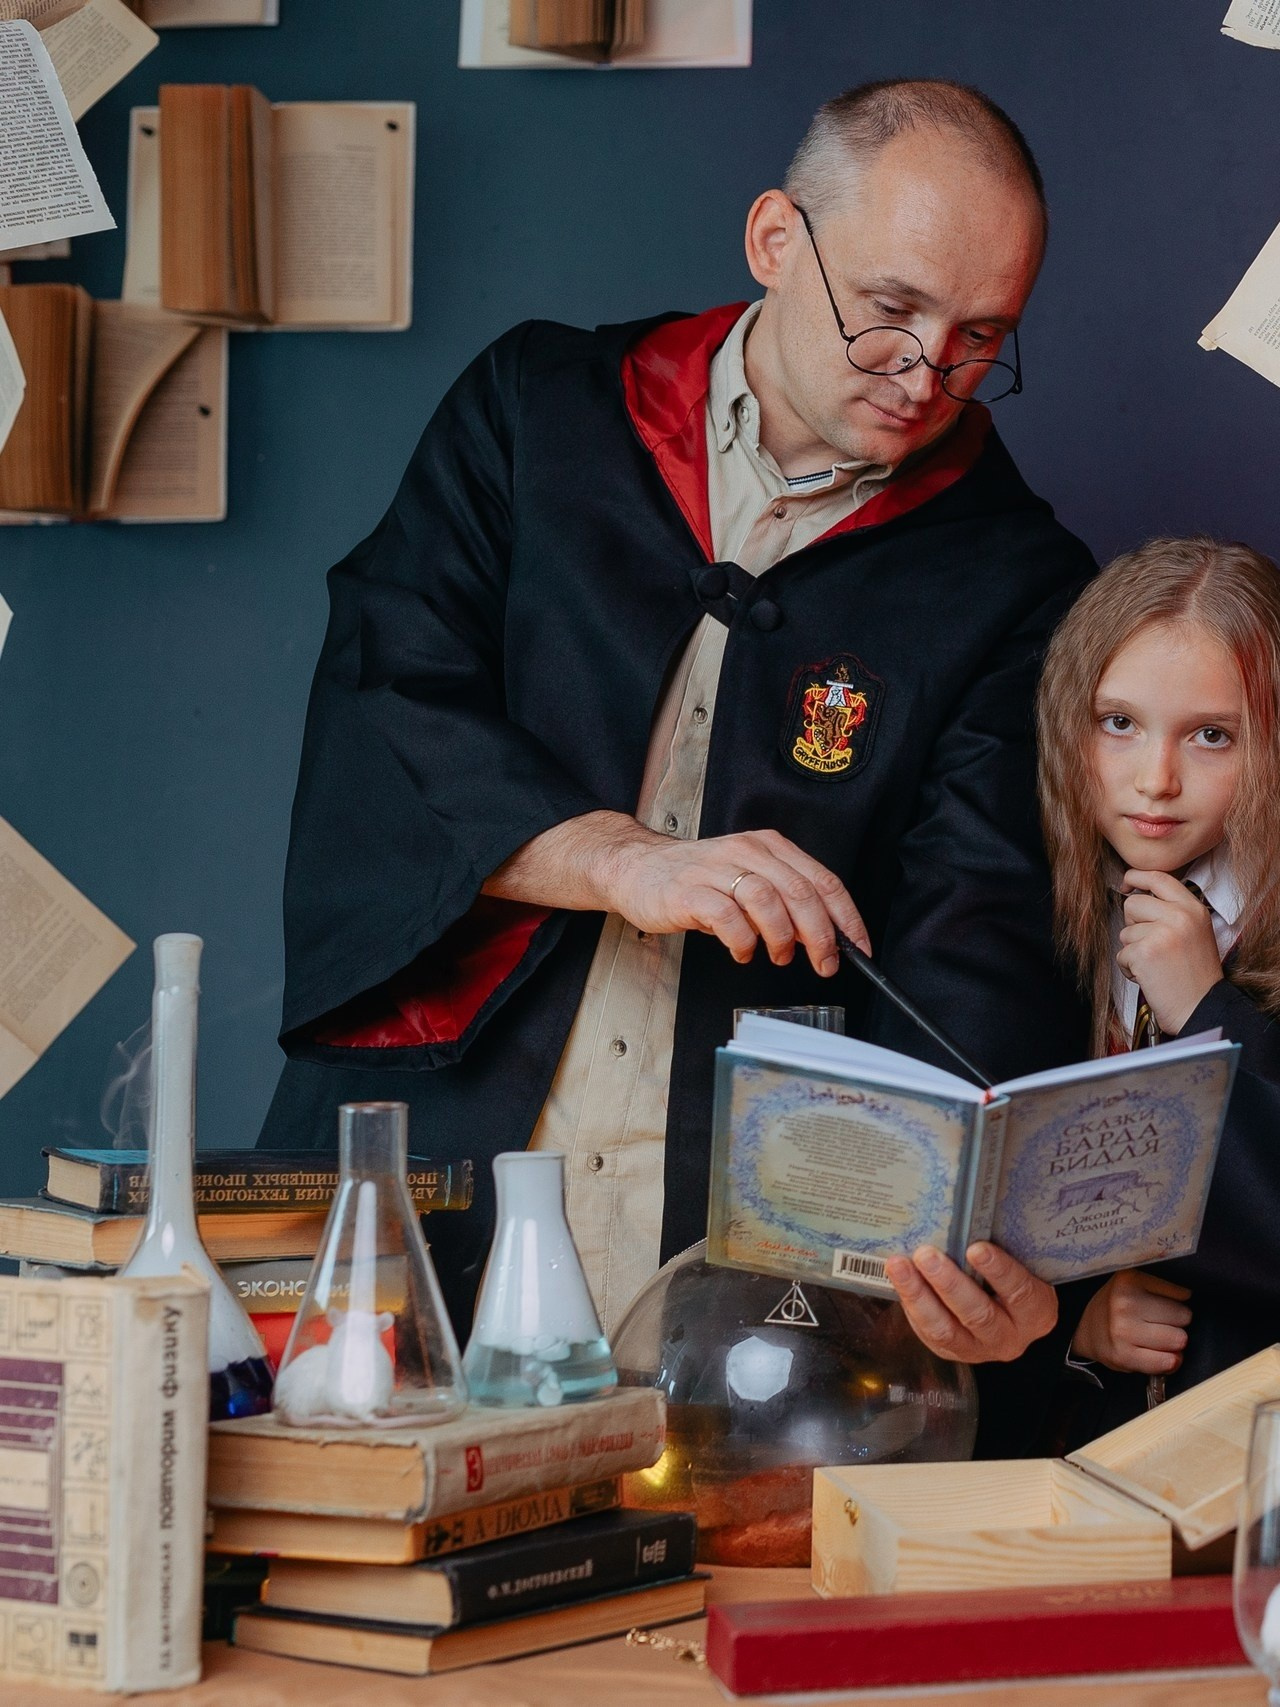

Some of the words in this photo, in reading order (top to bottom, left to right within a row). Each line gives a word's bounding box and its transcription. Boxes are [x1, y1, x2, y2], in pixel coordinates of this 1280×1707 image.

[794, 746, 849, 770] GRYFFINDOR
[1056, 1123, 1158, 1157] БАРДА
[1063, 1108, 1156, 1137] СКАЗКИ
[1048, 1139, 1159, 1176] БИДЛЯ
[159, 1305, 185, 1398] физику
[154, 1408, 181, 1530] повторим
